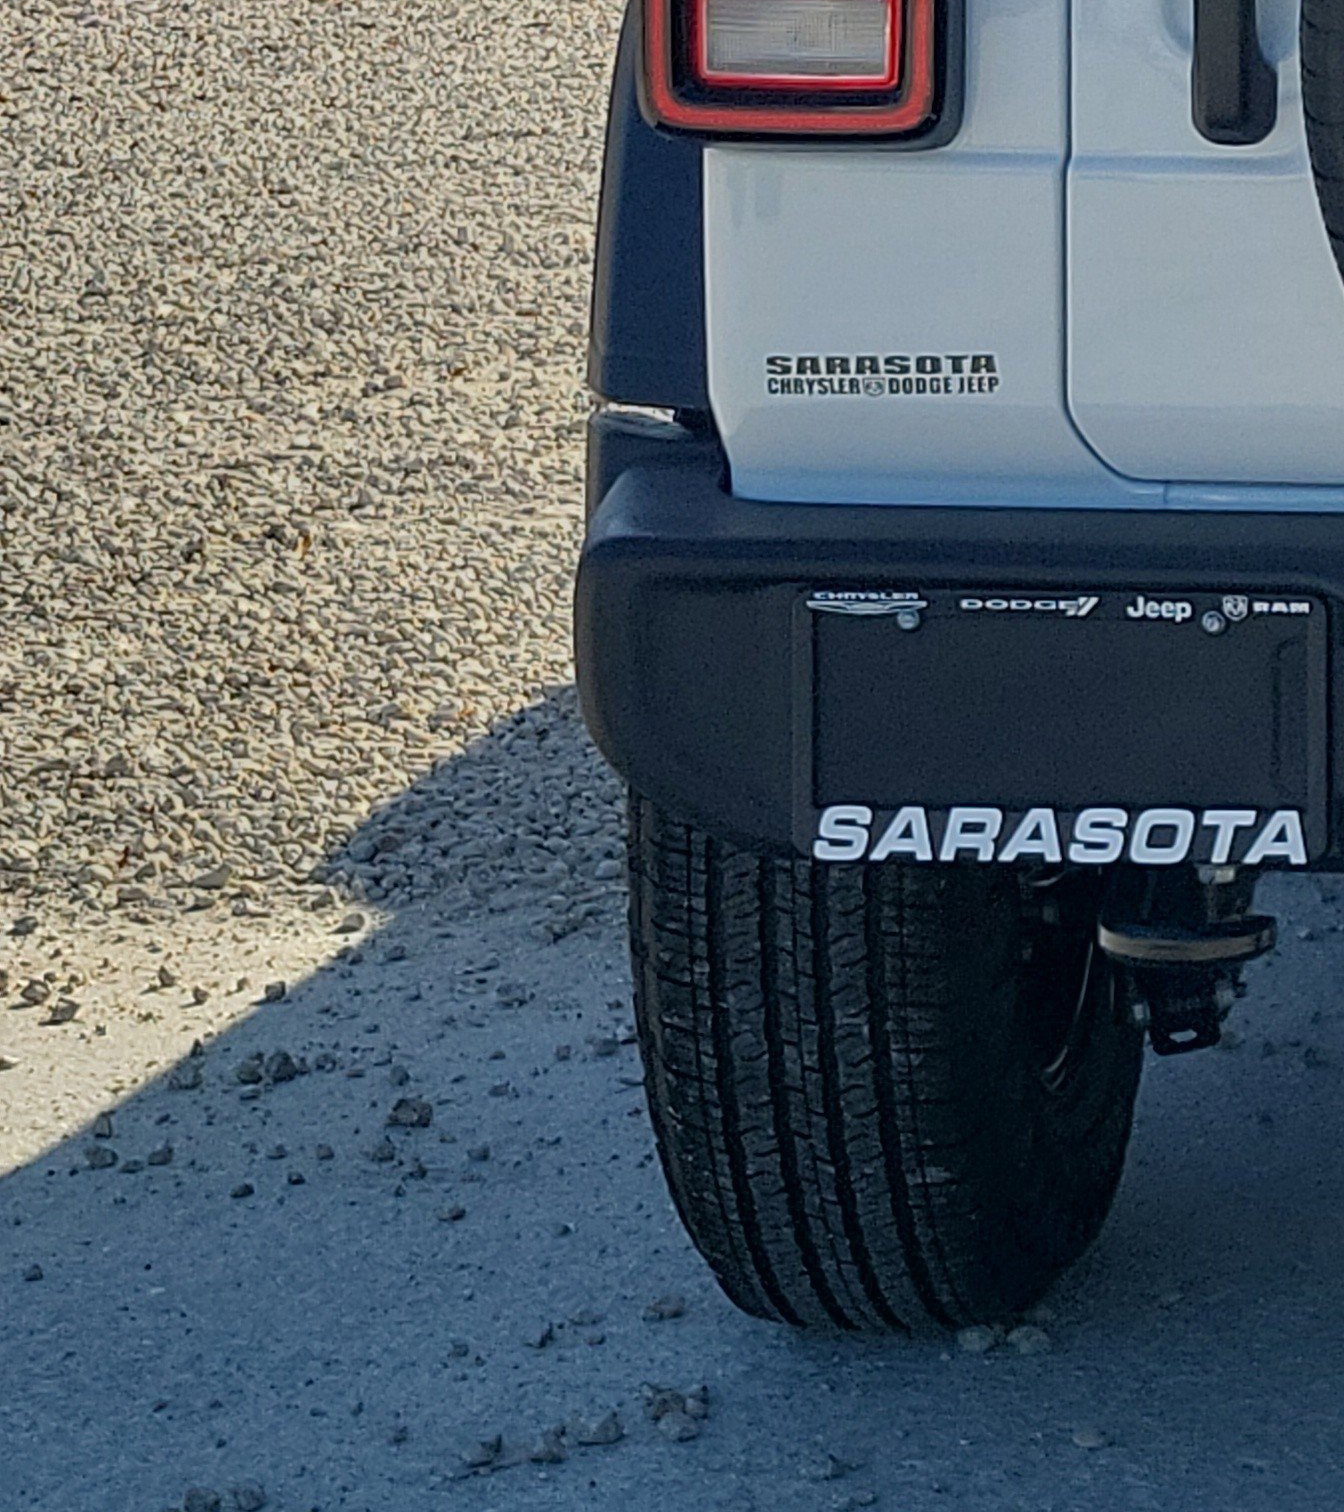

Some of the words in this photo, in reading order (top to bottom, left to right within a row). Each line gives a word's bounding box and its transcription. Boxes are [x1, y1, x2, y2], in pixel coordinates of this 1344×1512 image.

[765, 354, 998, 376] SARASOTA
[767, 376, 862, 395] CHRYSLER
[887, 376, 952, 395] DODGE
[957, 375, 1000, 394] JEEP
[812, 591, 919, 600] CHRYSLER
[1126, 595, 1193, 623] Jeep
[1252, 601, 1311, 614] RAM
[812, 804, 1309, 866] SARASOTA
